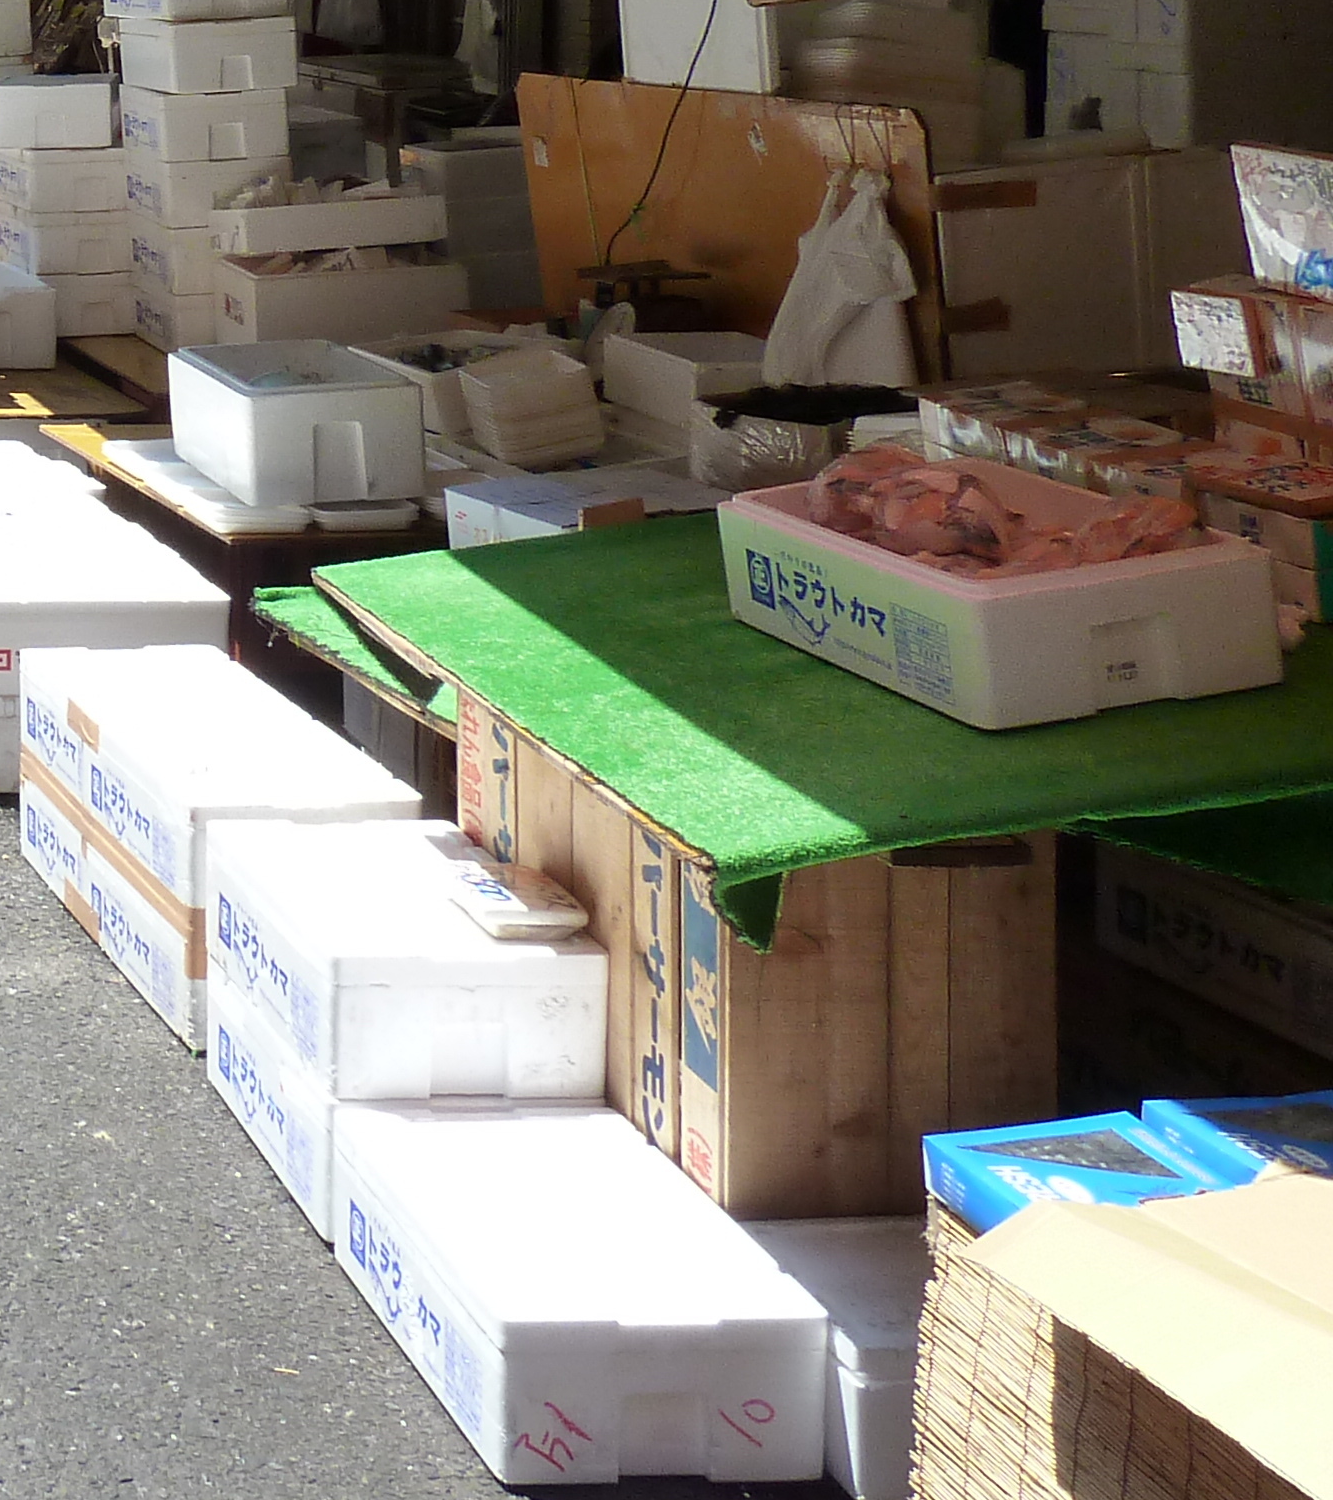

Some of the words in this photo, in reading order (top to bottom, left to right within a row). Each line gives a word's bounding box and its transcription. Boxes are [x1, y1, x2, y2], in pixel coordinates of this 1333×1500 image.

[776, 561, 887, 638] トラウトカマ
[36, 706, 77, 763] トラウトカマ
[37, 811, 77, 875] トラウトカマ
[103, 774, 151, 840] トラウトカマ
[103, 894, 151, 966] トラウトカマ
[233, 909, 289, 998] トラウトカマ
[232, 1042, 285, 1136] トラウトカマ
[368, 1225, 442, 1348] トラウカマ
